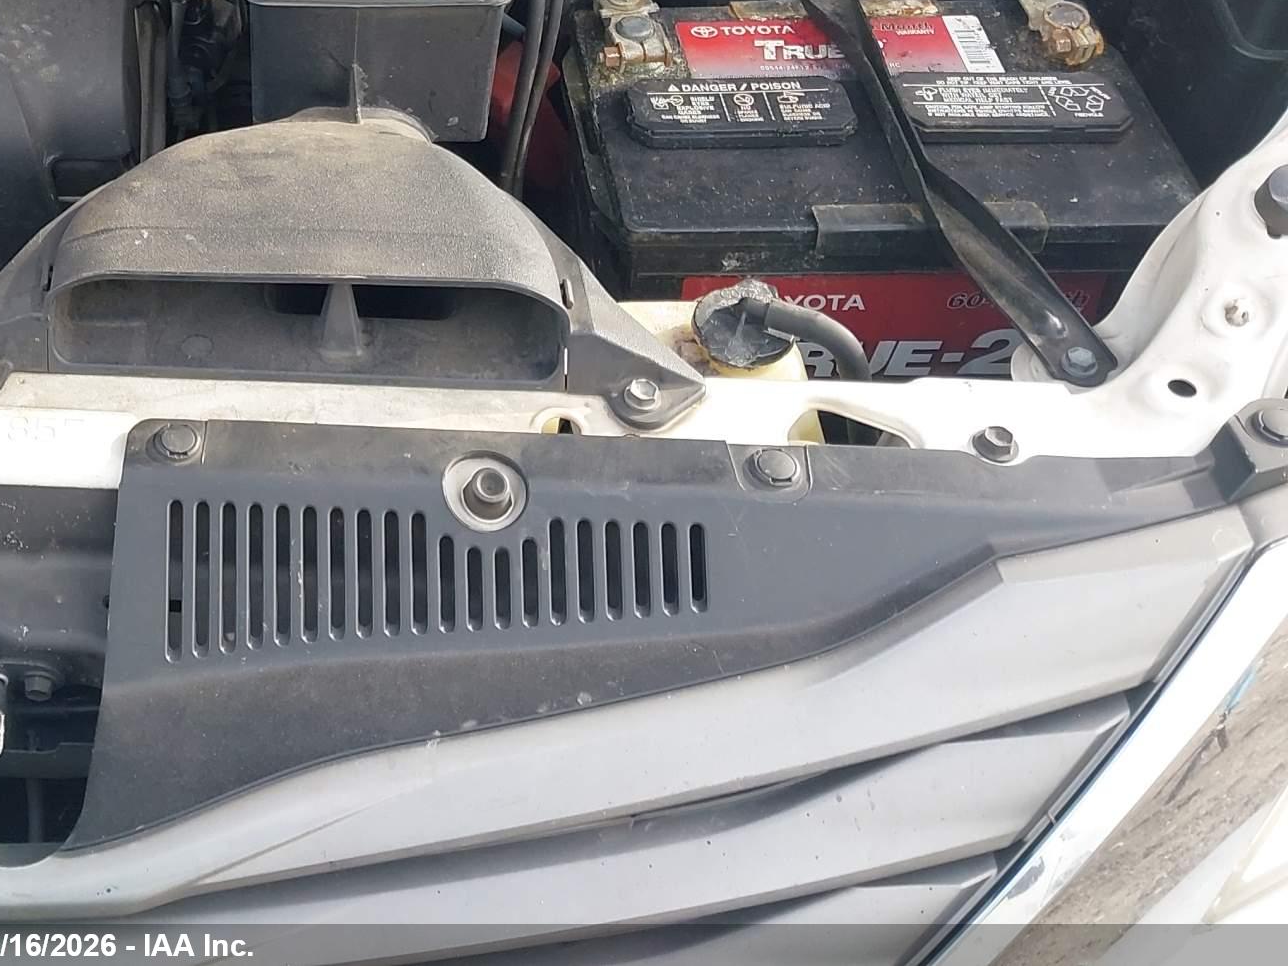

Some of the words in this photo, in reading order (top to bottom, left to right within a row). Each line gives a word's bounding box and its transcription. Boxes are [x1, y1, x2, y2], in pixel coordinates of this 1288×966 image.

[720, 25, 795, 35] TOYOTA
[681, 83, 738, 92] DANGER
[750, 81, 802, 91] POISON
[783, 294, 866, 311] YOTA
